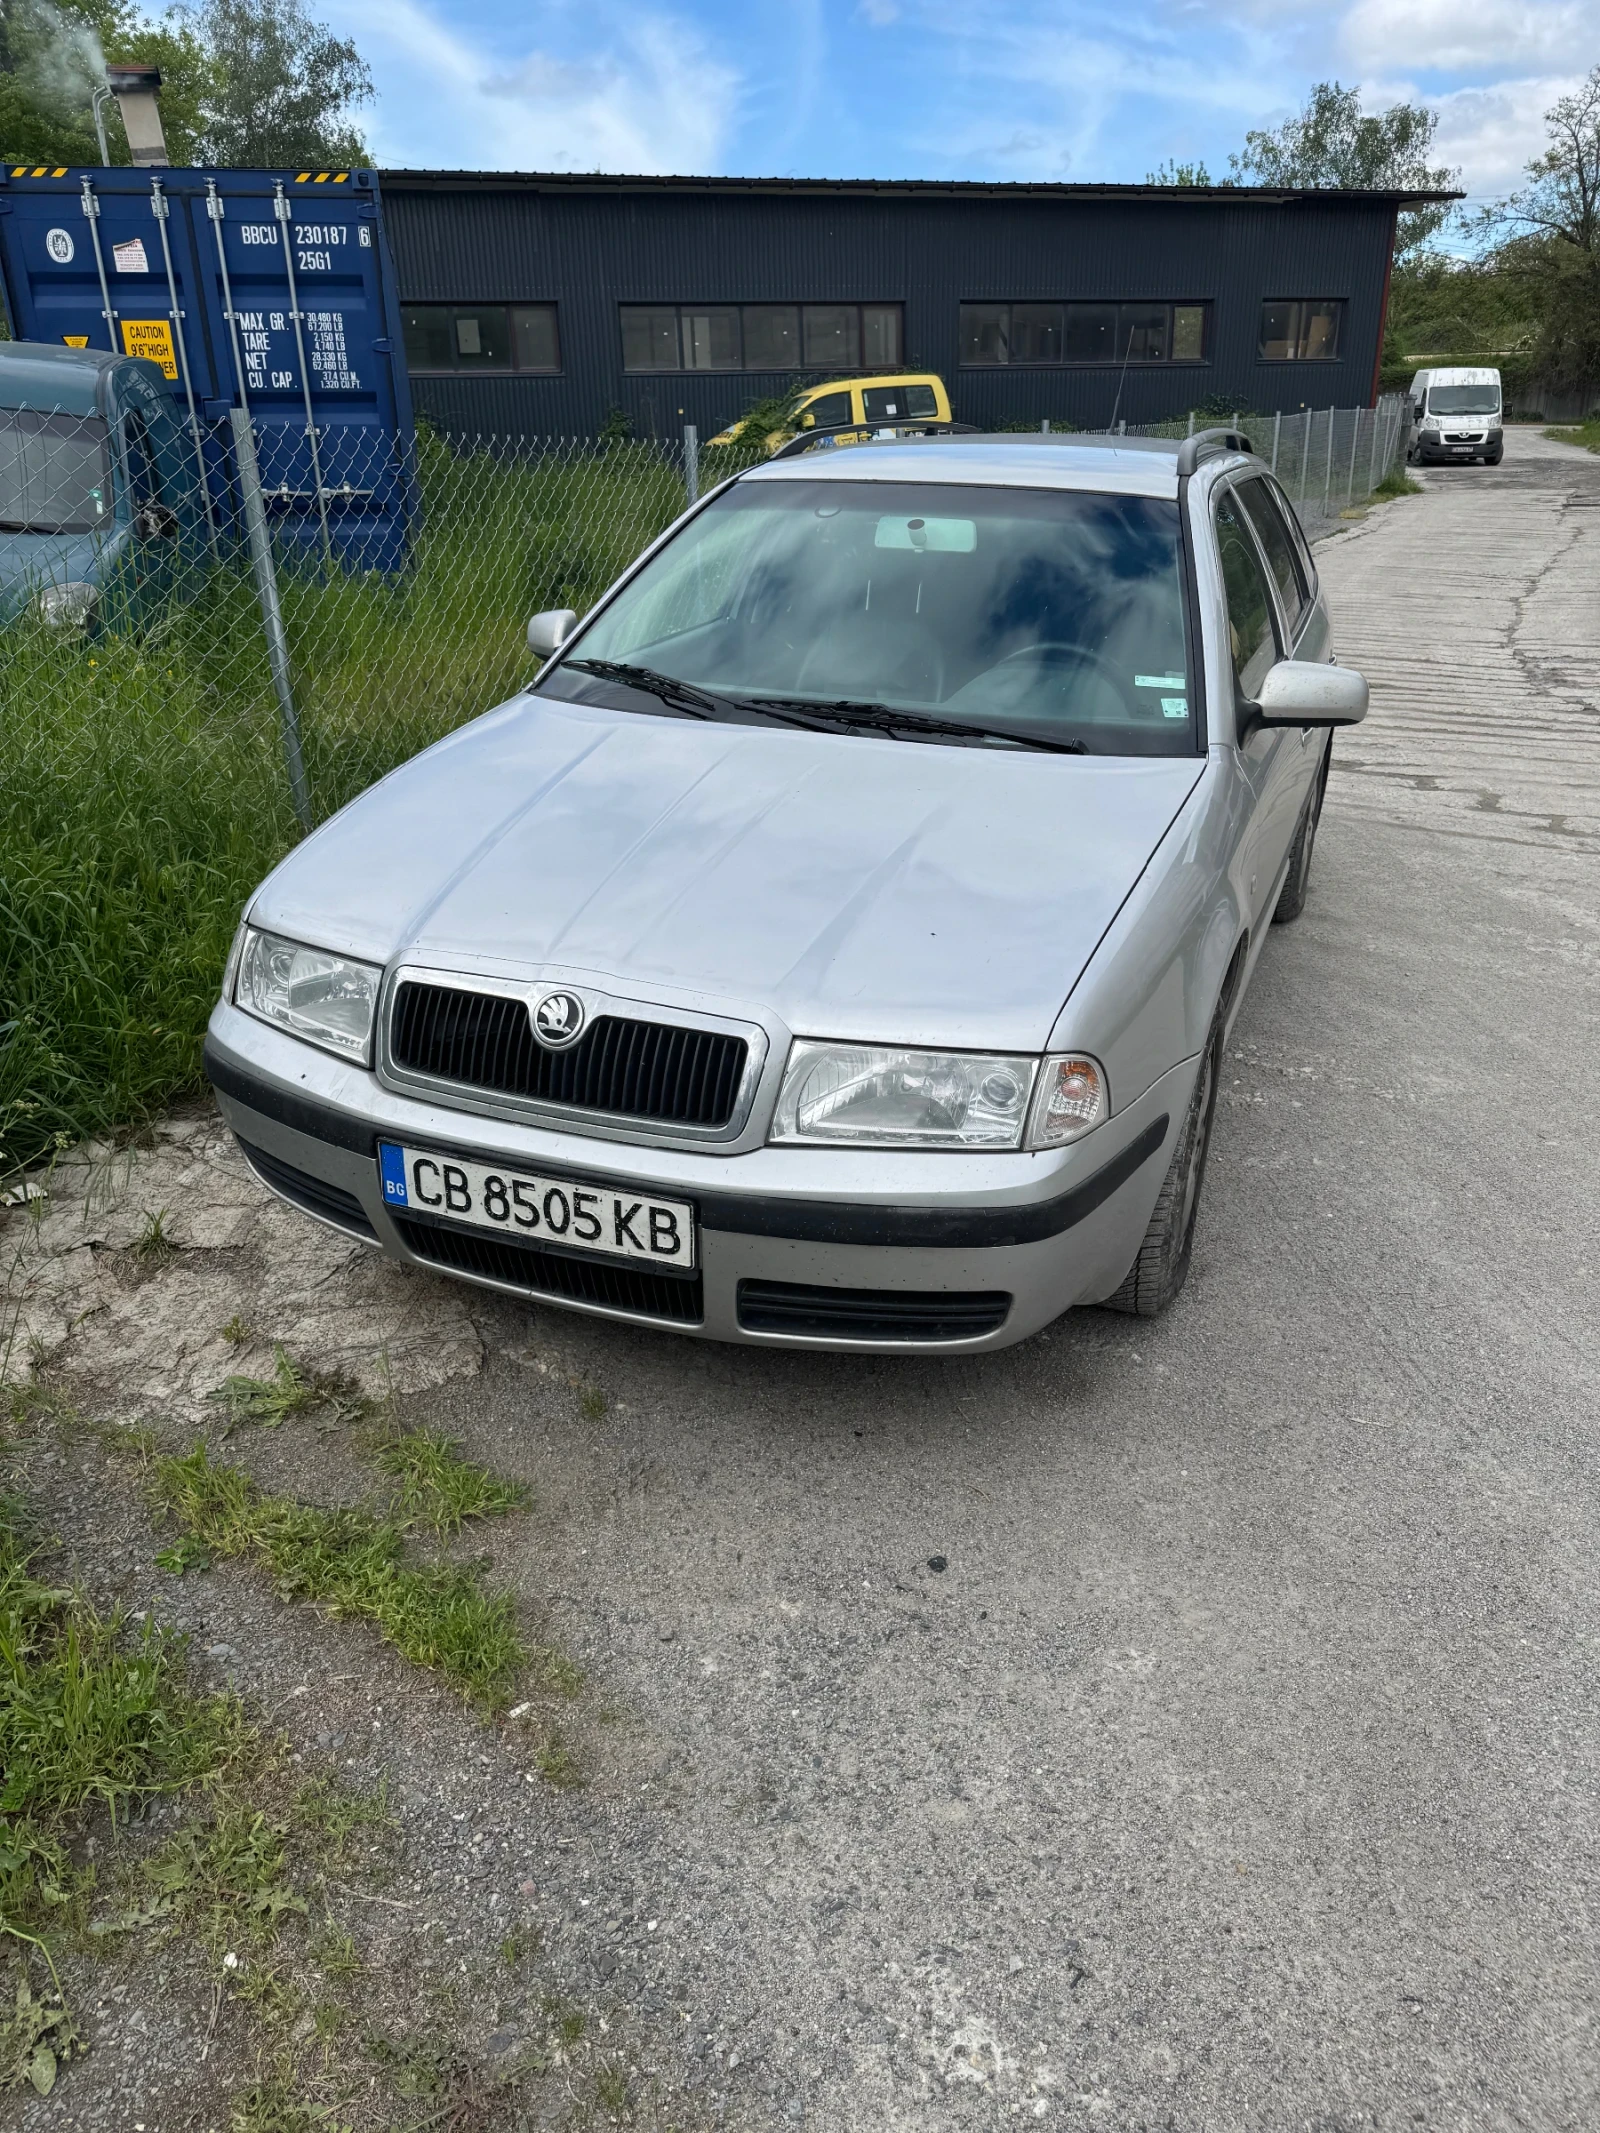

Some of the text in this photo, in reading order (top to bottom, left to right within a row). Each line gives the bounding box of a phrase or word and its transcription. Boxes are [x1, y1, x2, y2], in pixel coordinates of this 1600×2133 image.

[241, 226, 370, 245] BBCU 230187 6
[298, 251, 332, 270] 25G1
[240, 312, 290, 331] MAX. GR.
[306, 312, 343, 322] 30.480 KG
[130, 326, 165, 339] CAUTION
[307, 321, 344, 331] 67.200 LB
[242, 332, 271, 351] TARE
[313, 332, 345, 342] 2.150 KG
[314, 341, 346, 351] 4.740 LB
[245, 352, 268, 370] NET
[337, 352, 348, 361] KG
[338, 361, 348, 371] LB
[248, 371, 298, 389] CU. CAP.
[386, 1180, 406, 1197] BG
[412, 1157, 682, 1256] CB 8505 KB
